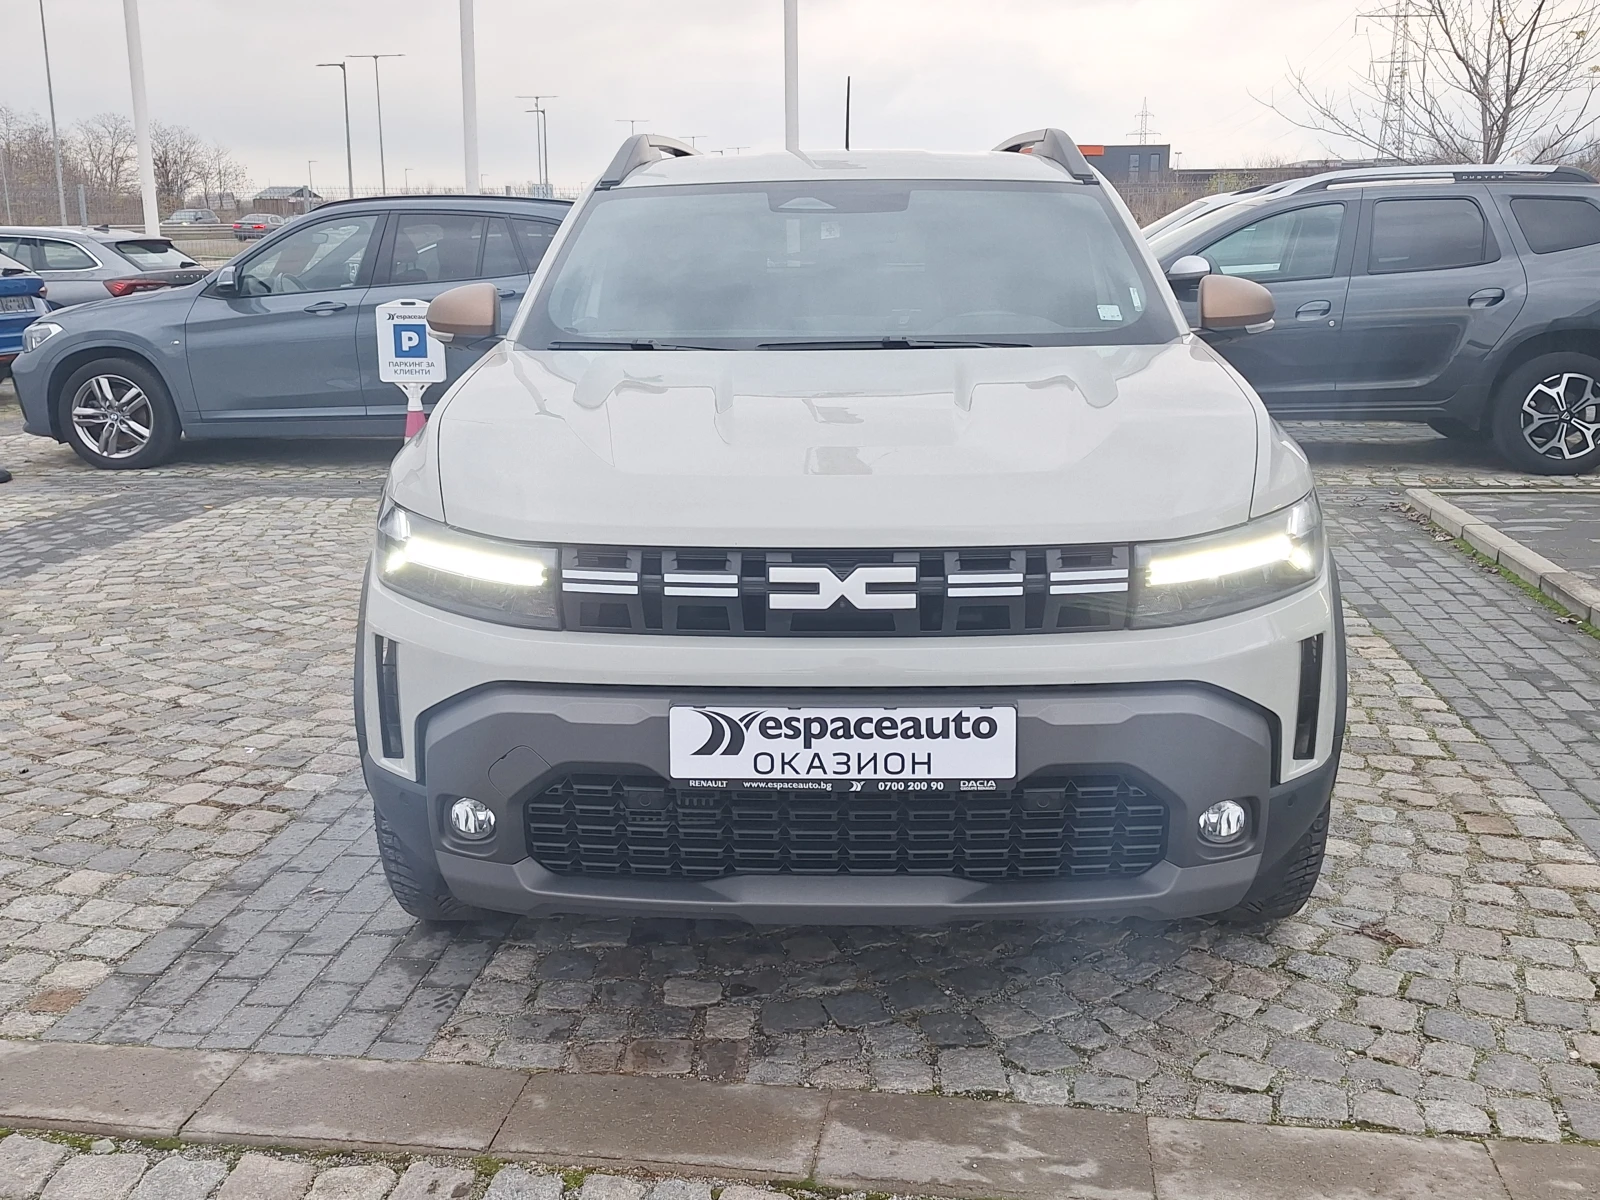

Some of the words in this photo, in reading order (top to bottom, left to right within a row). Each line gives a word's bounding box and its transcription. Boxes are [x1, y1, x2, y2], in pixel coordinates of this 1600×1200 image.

[758, 709, 998, 749] espaceauto
[753, 752, 932, 775] ОКАЗИОН
[689, 780, 728, 788] RENAULT
[742, 781, 833, 791] www.espaceauto.bg
[878, 782, 904, 790] 0700
[907, 782, 927, 790] 200
[930, 782, 944, 790] 90
